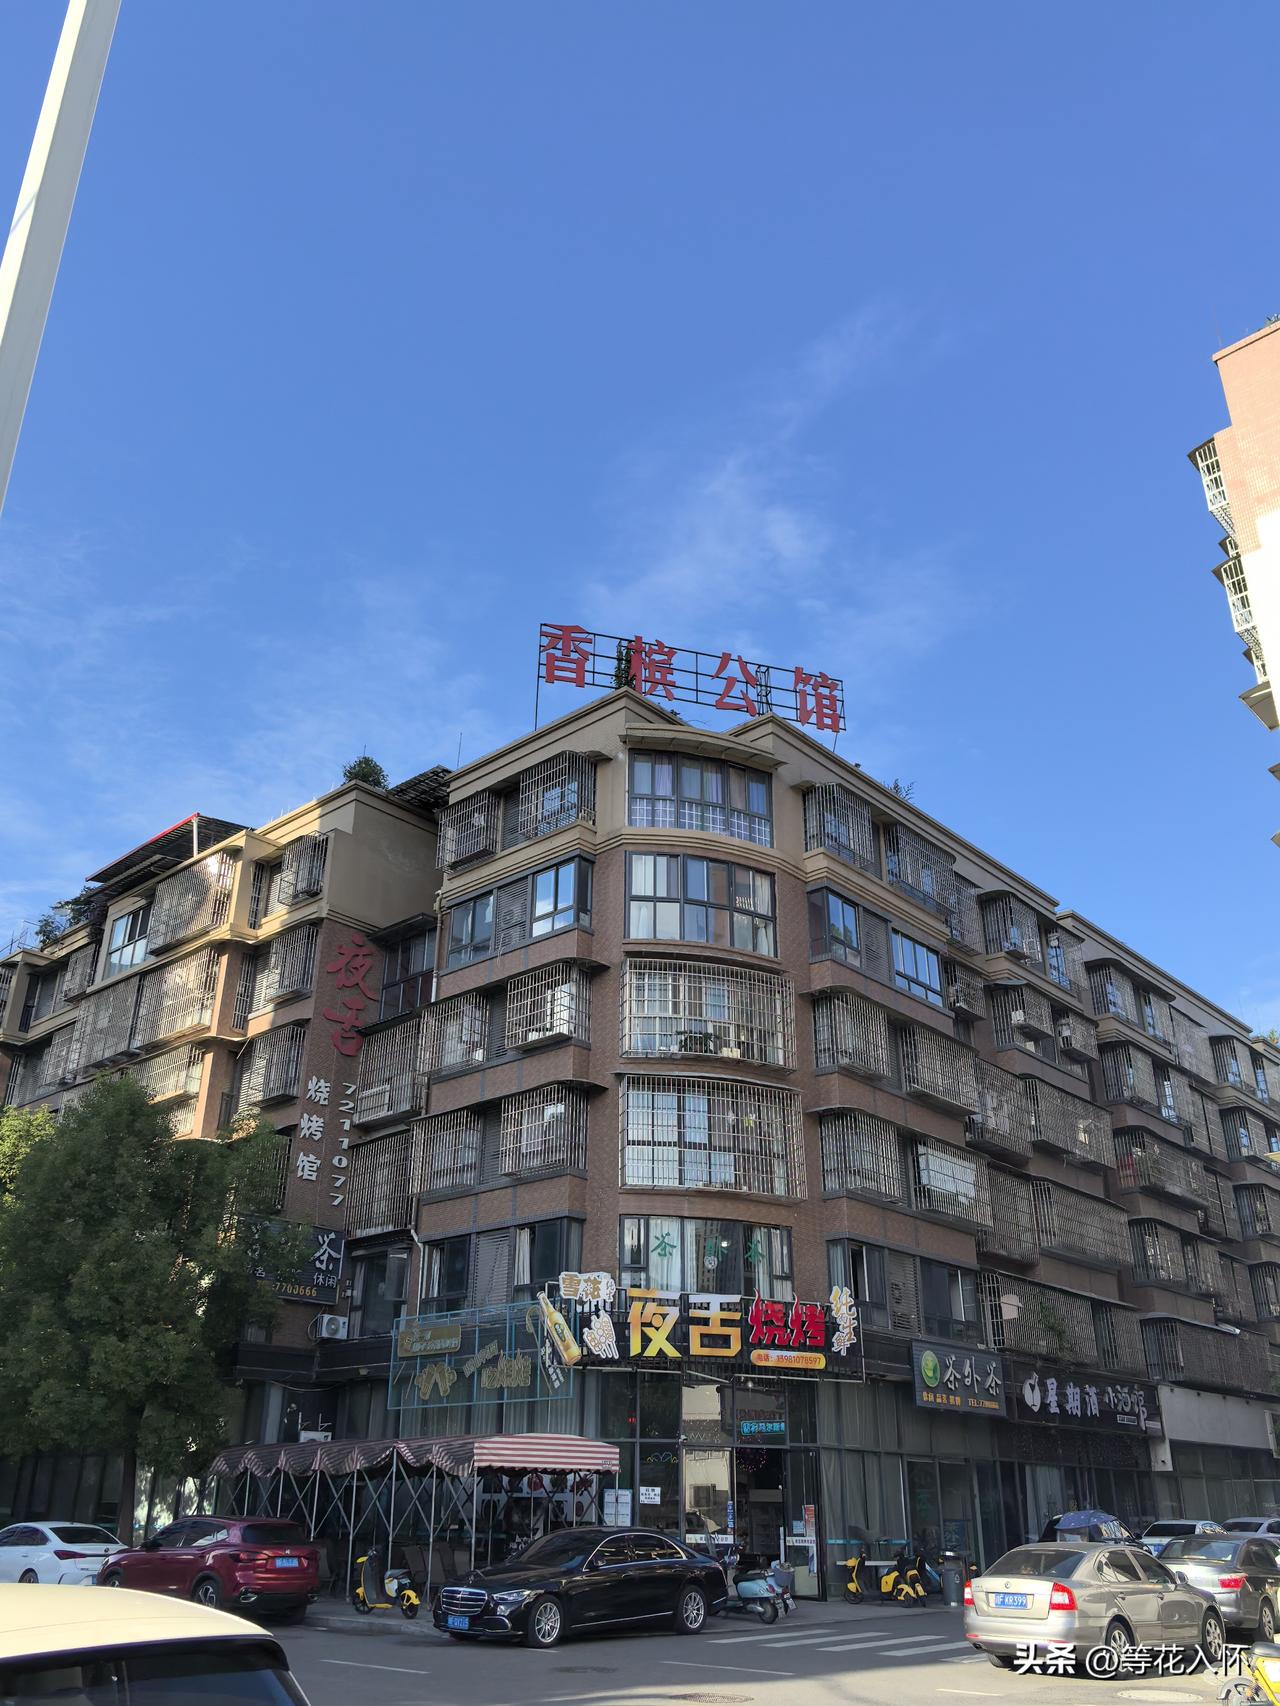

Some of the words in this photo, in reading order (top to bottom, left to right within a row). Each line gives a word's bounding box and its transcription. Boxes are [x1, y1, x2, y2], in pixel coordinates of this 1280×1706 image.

[541, 623, 840, 733] 香槟公馆
[296, 1075, 331, 1181] 烧烤馆
[329, 1082, 356, 1206] 7211077
[626, 1288, 743, 1358] 夜舌
[749, 1288, 825, 1347] 烧烤
[943, 1354, 1002, 1397] 茶外茶
